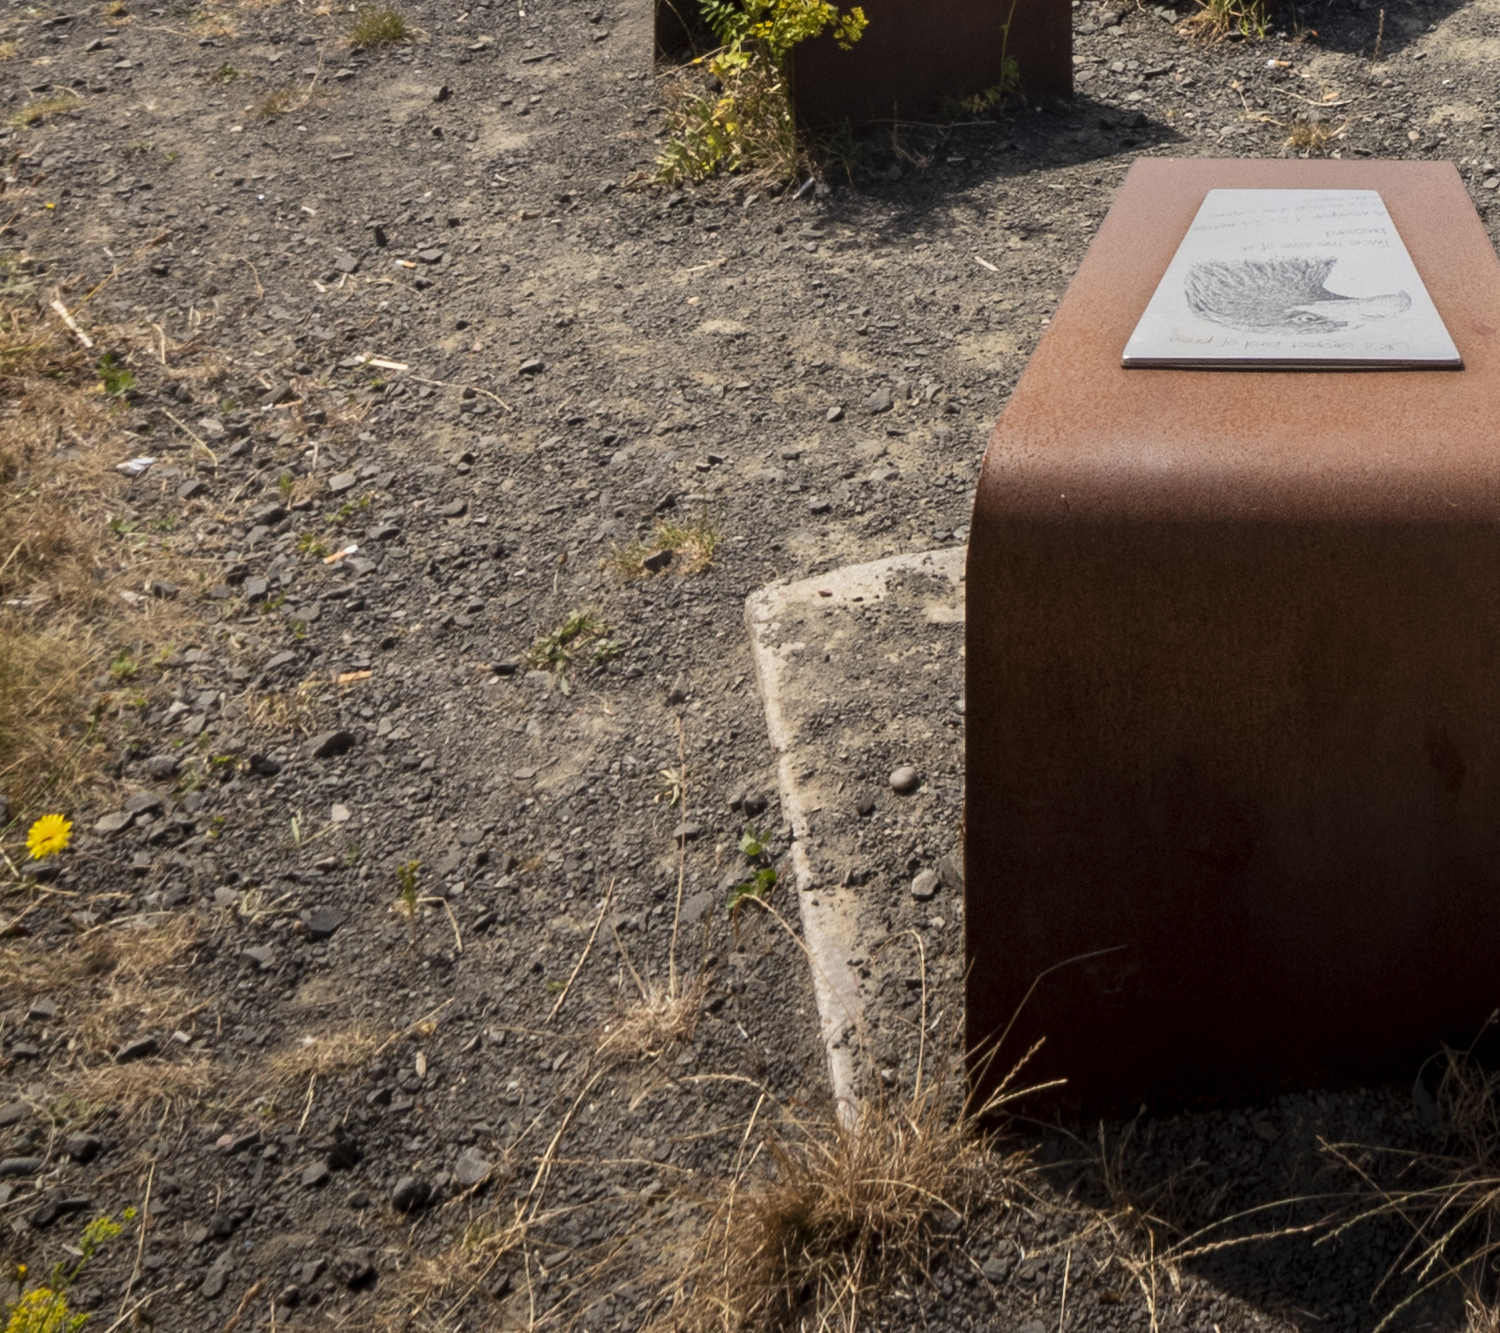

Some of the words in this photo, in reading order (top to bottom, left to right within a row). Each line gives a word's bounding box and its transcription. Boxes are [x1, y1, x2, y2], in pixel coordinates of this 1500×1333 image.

[1324, 228, 1388, 238] buzzard
[1259, 243, 1274, 252] of
[1318, 240, 1343, 248] the
[1221, 337, 1238, 349] of
[1245, 340, 1282, 350] bird
[1292, 339, 1354, 350] largest
